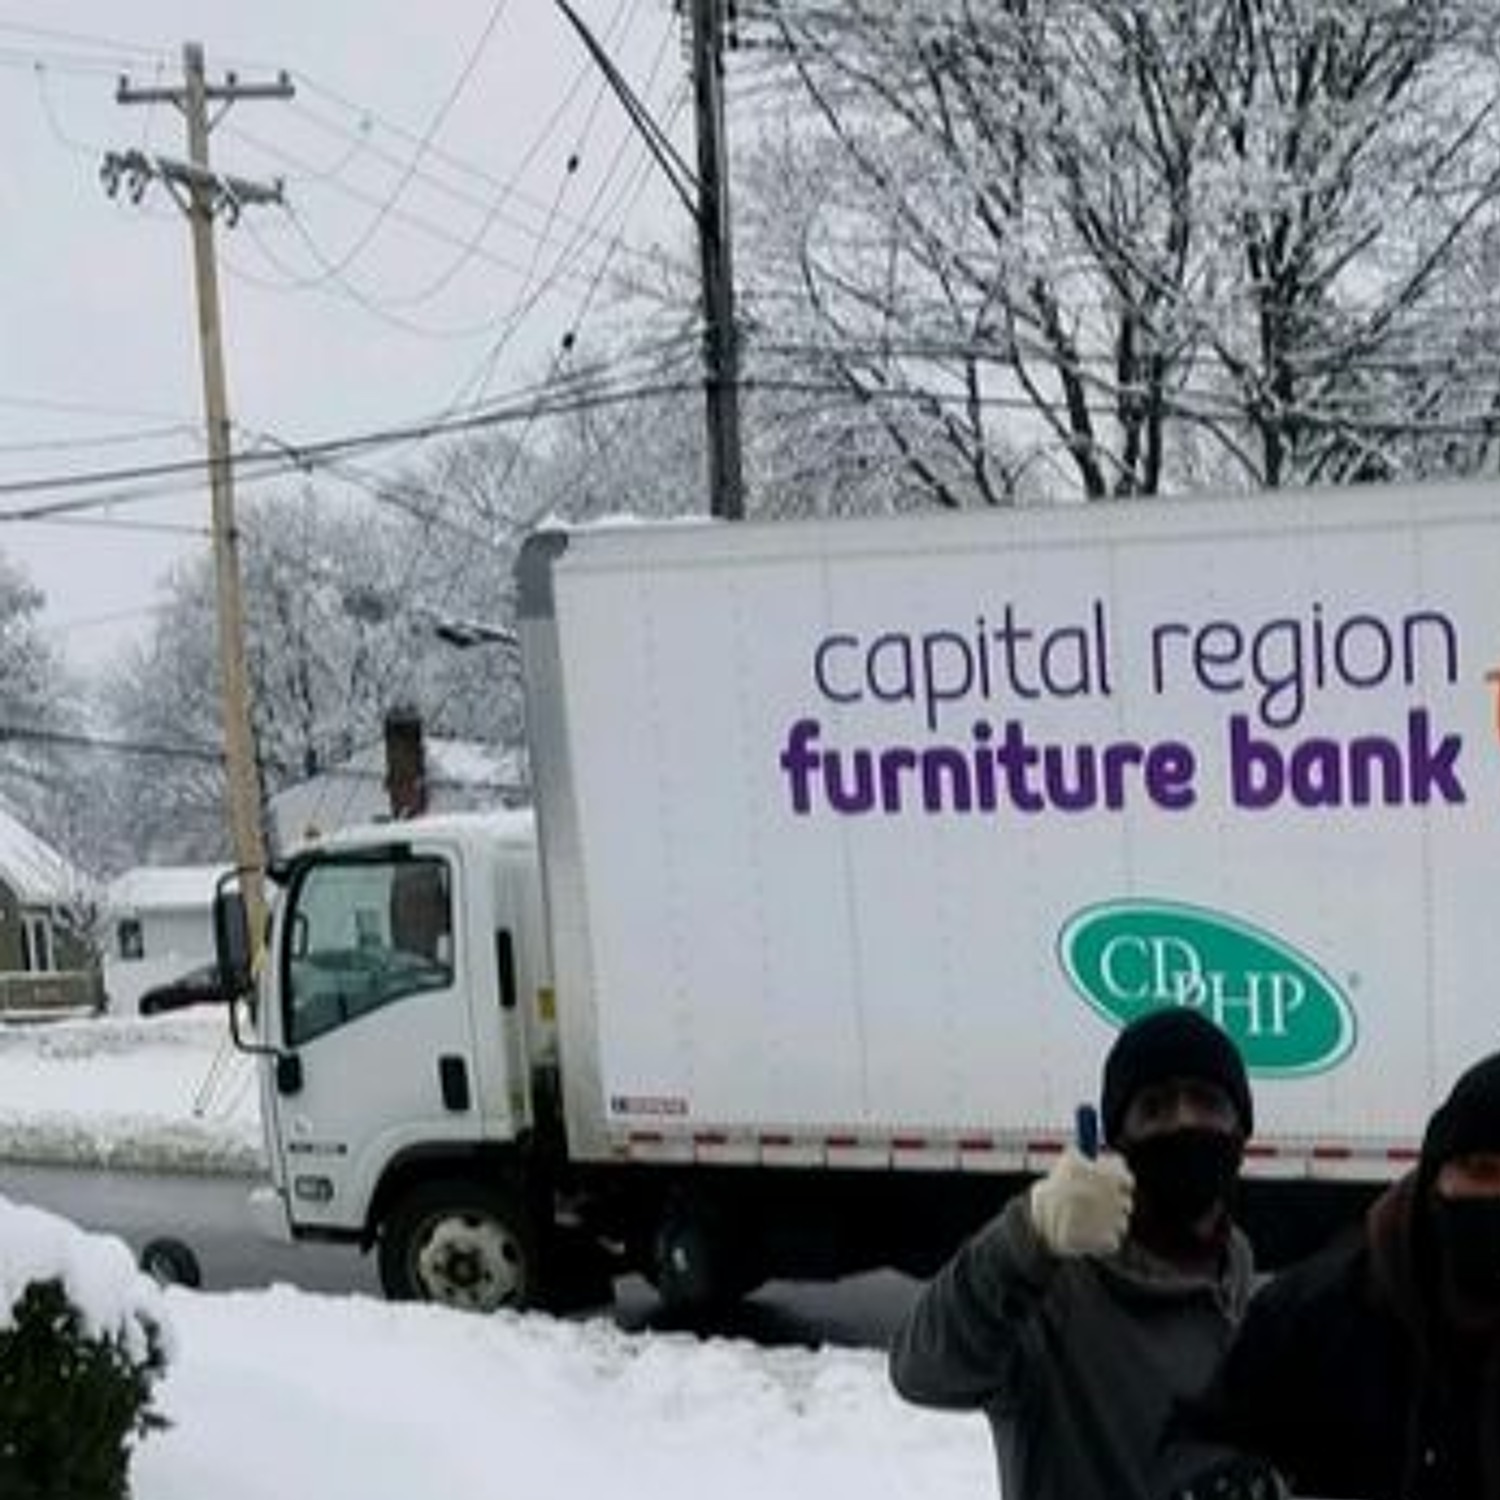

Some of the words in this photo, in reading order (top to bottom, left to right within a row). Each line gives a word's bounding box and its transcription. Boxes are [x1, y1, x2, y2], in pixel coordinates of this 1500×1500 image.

[813, 598, 1114, 735] capital
[1151, 601, 1459, 731] region
[779, 717, 1198, 817] furniture
[1228, 705, 1468, 811] bank
[1100, 934, 1306, 1036] CDPHP
